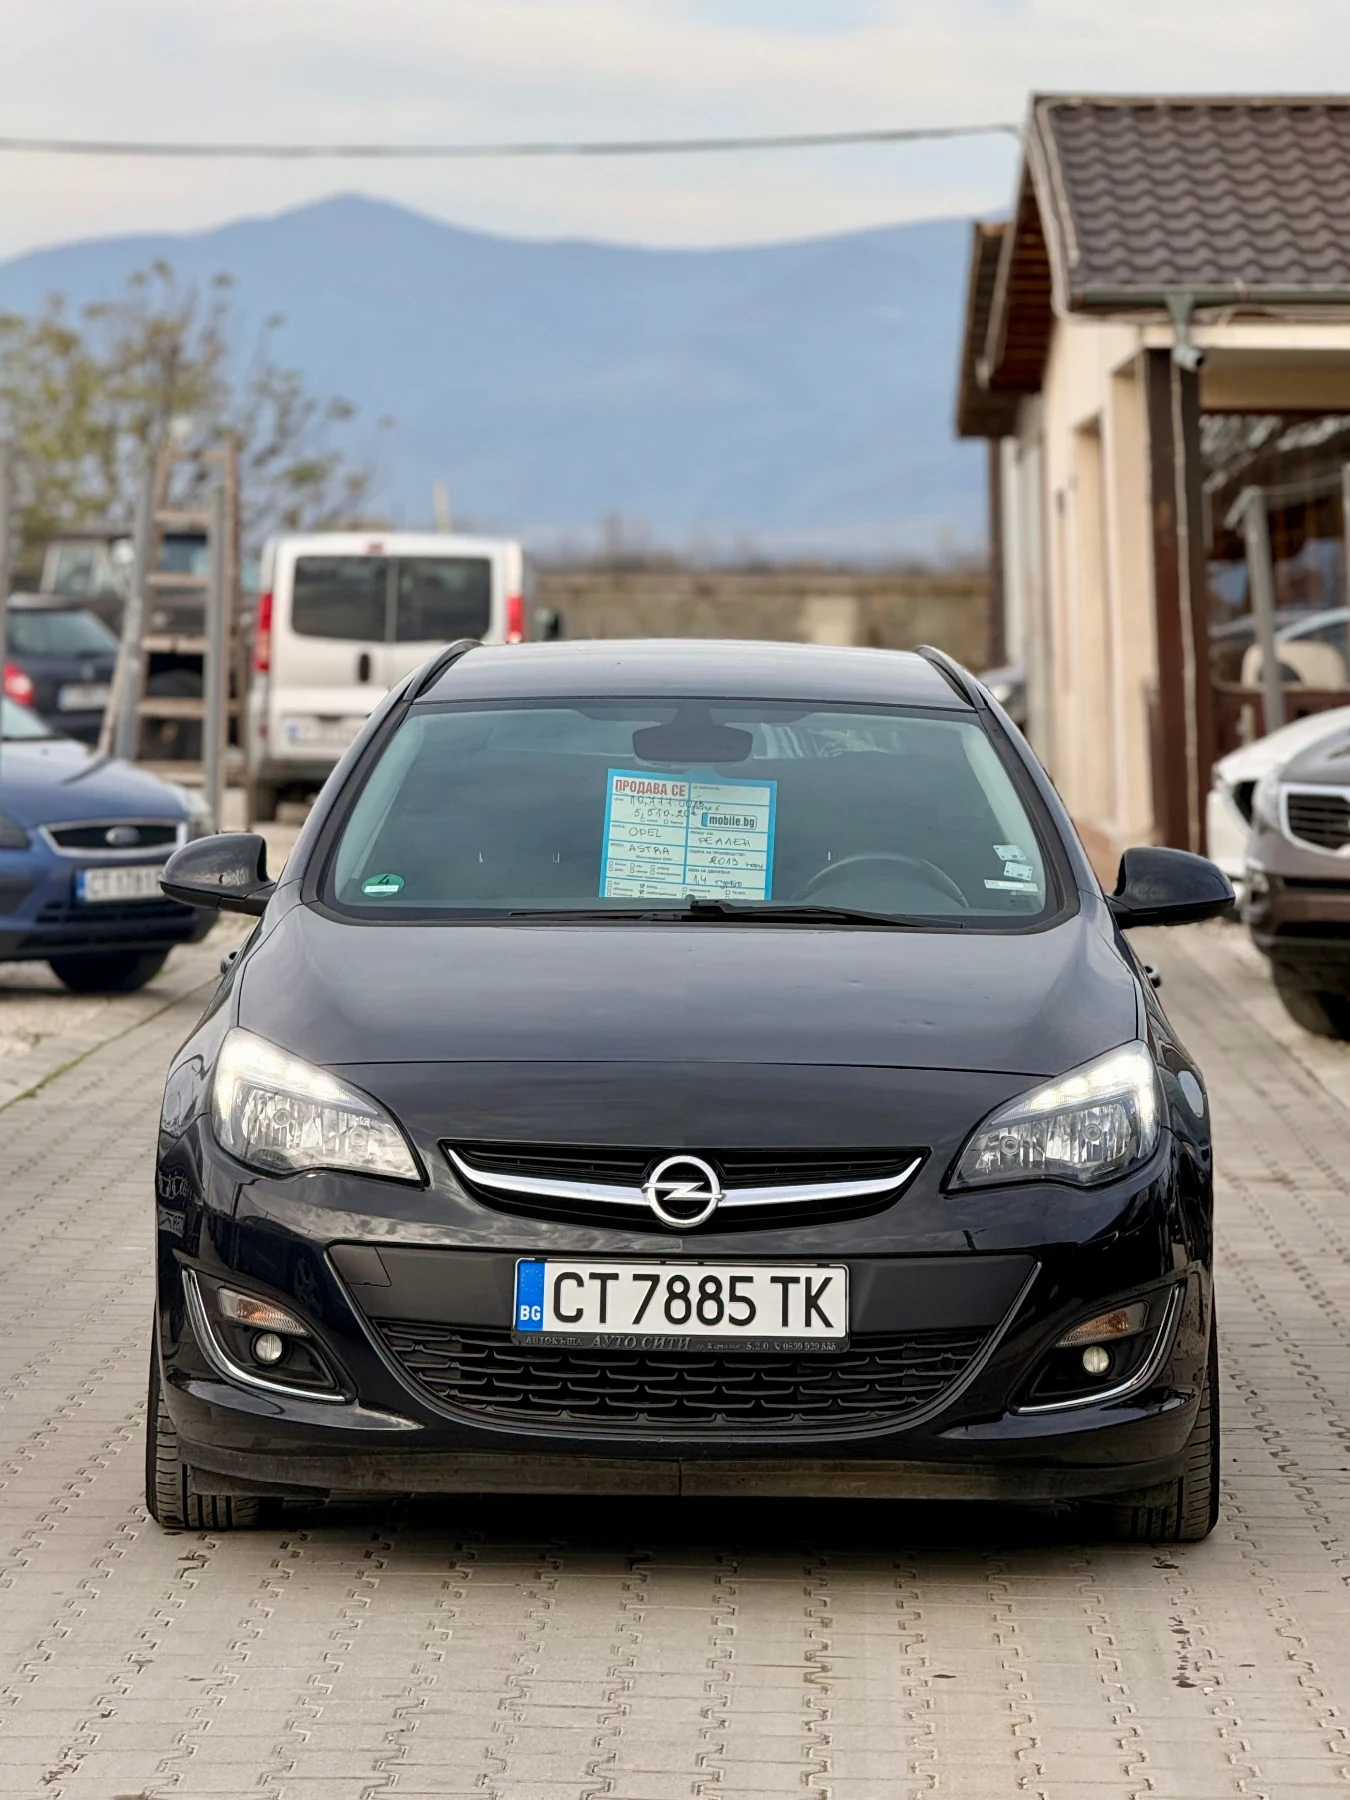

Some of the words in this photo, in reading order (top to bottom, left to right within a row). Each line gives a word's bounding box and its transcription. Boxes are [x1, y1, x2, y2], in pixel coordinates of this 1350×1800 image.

[615, 779, 667, 795] ПРОДАВА
[671, 784, 686, 797] СЕ
[708, 815, 755, 828] mobile.bg
[628, 827, 662, 838] OPEL
[628, 844, 670, 855] ASTRA
[377, 874, 390, 886] 4
[553, 1271, 620, 1324] CT
[632, 1273, 757, 1327] 7885
[770, 1275, 834, 1328] TK
[520, 1305, 541, 1321] BG
[525, 1336, 583, 1347] АВТОКЪЩА
[590, 1334, 637, 1349] АУТО
[641, 1336, 692, 1350] СИТИ
